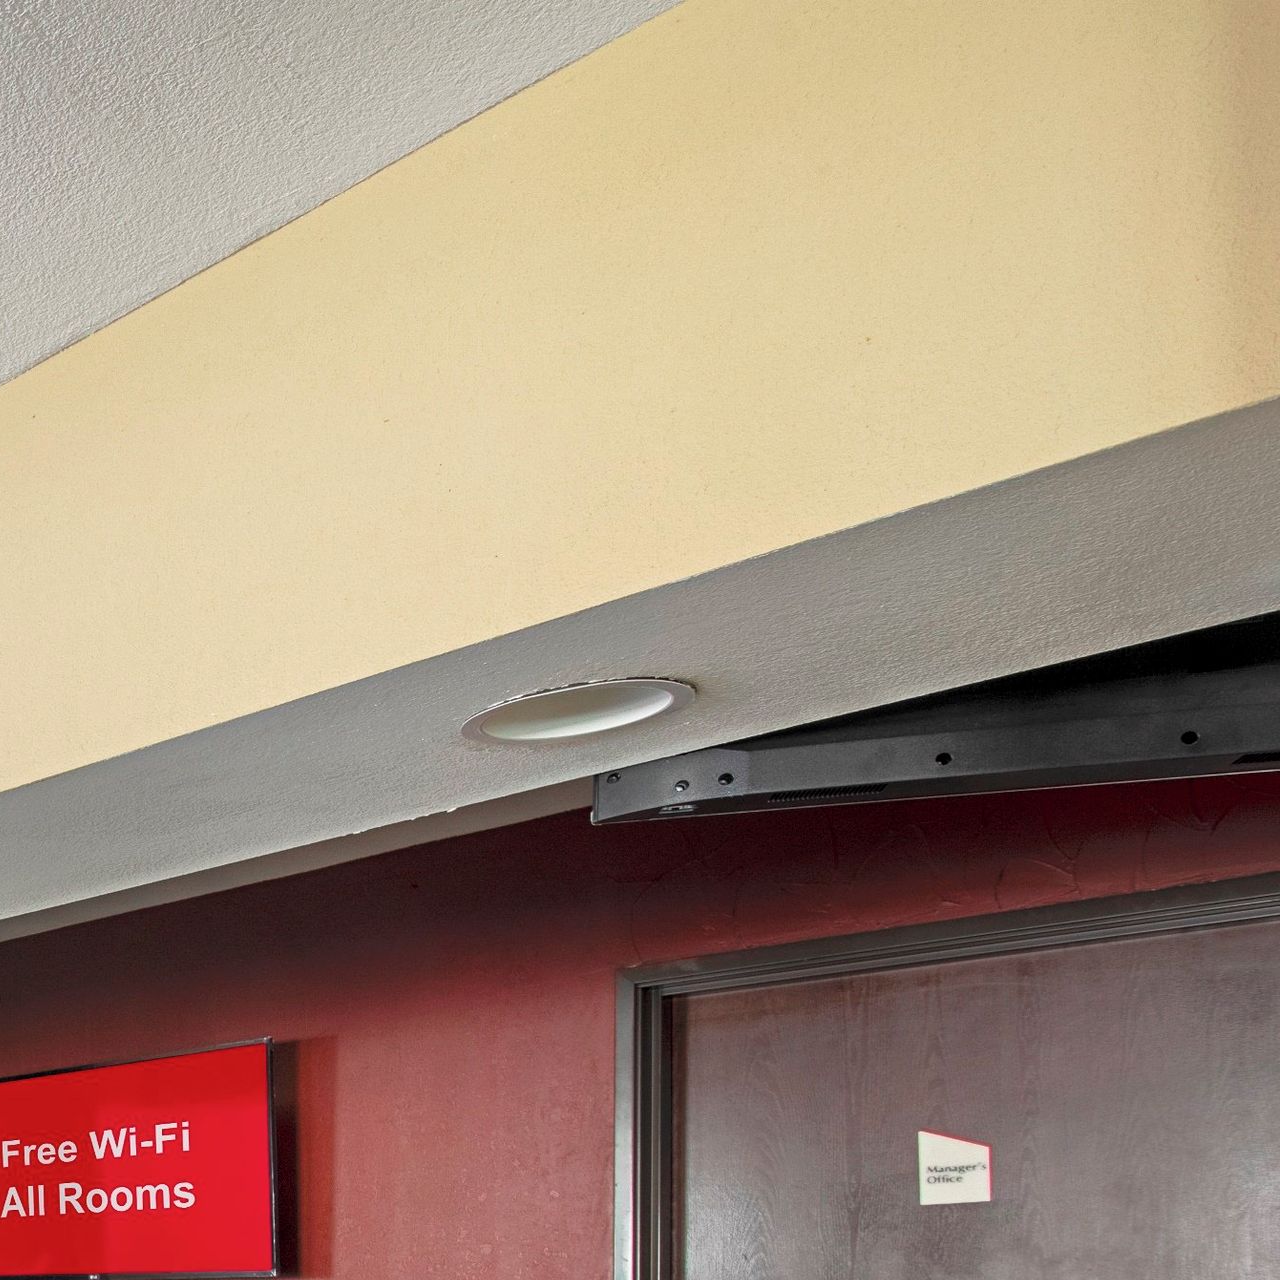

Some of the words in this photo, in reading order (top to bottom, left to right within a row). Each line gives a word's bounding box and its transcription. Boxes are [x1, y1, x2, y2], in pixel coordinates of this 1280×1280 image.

[1, 1139, 78, 1168] Free
[88, 1121, 190, 1160] Wi-Fi
[926, 1162, 987, 1174] Manager's
[926, 1175, 964, 1184] Office
[0, 1184, 46, 1219] All
[58, 1180, 196, 1215] Rooms
